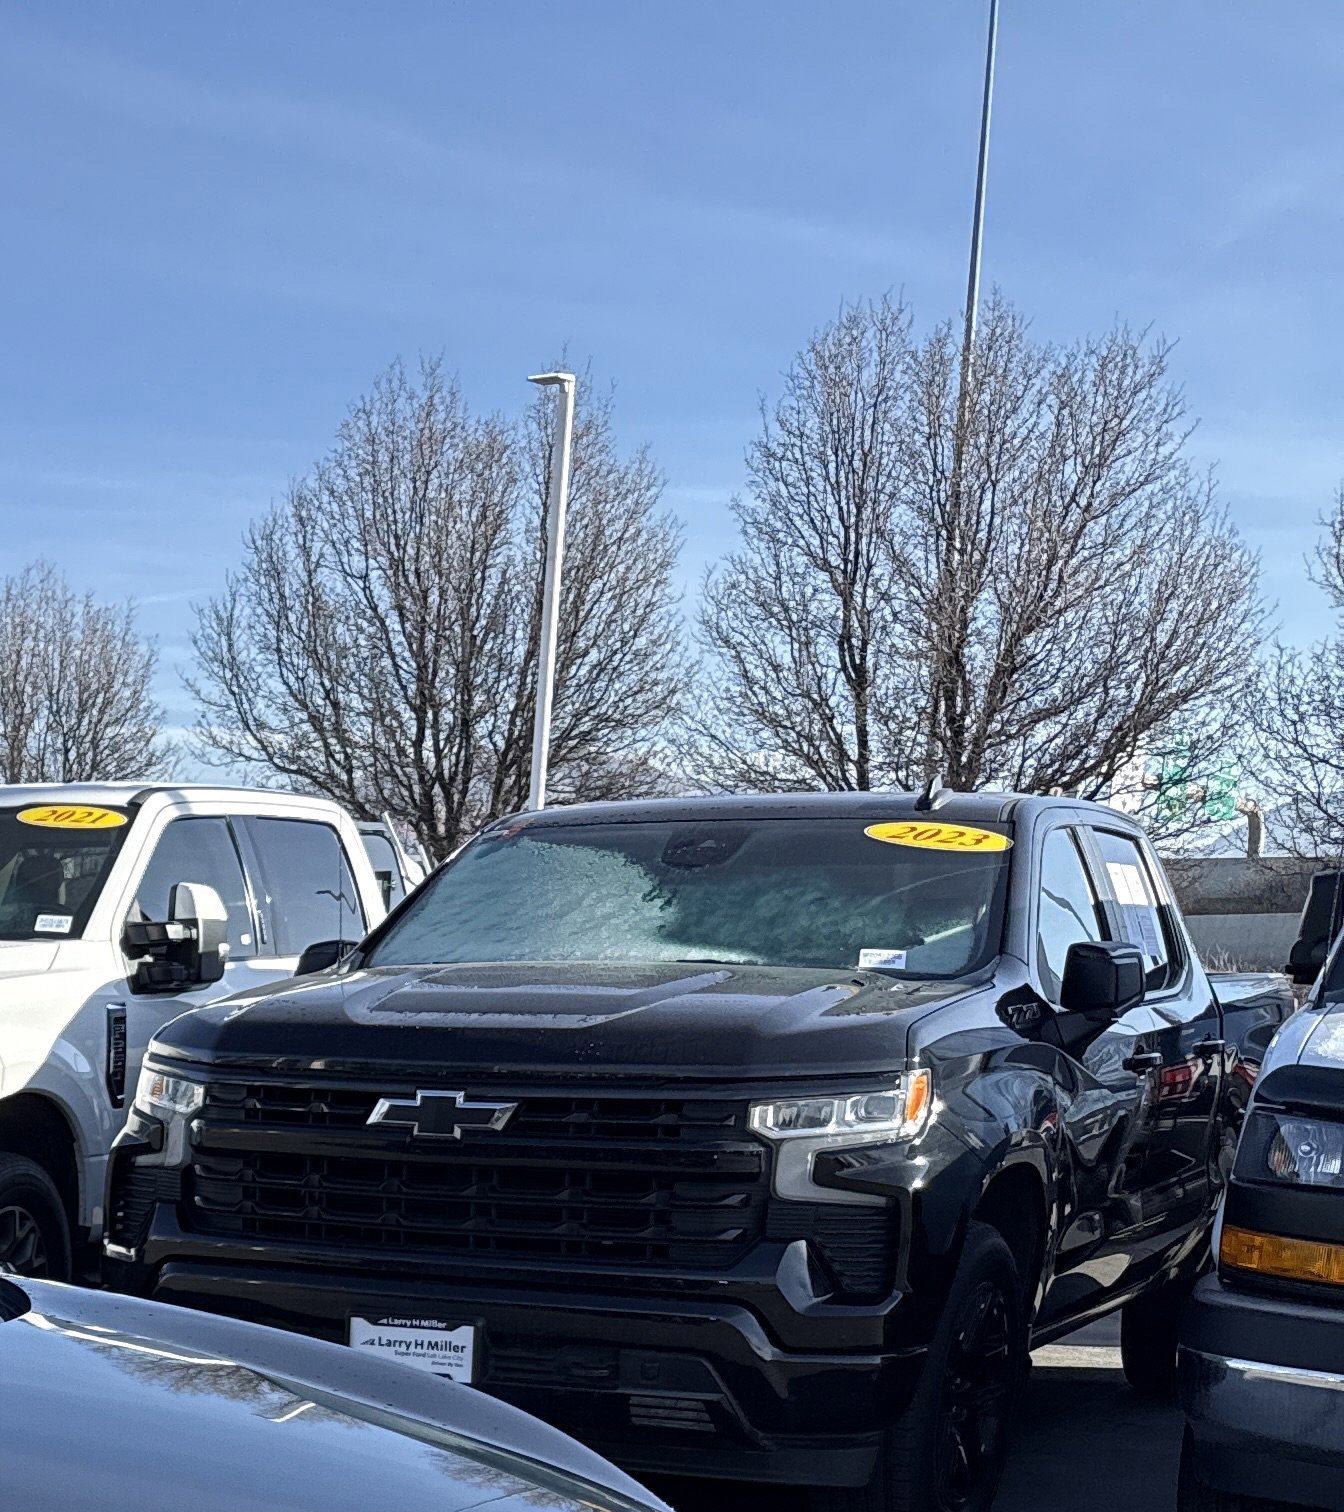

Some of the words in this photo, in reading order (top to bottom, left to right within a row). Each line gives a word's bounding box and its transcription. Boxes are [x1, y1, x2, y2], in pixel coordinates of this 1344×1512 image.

[34, 809, 109, 823] 2021
[887, 826, 990, 846] 2023
[388, 1316, 412, 1328] Larry
[421, 1319, 447, 1329] Miller
[378, 1336, 412, 1351] Larry
[414, 1338, 424, 1350] H
[427, 1339, 467, 1354] Miller
